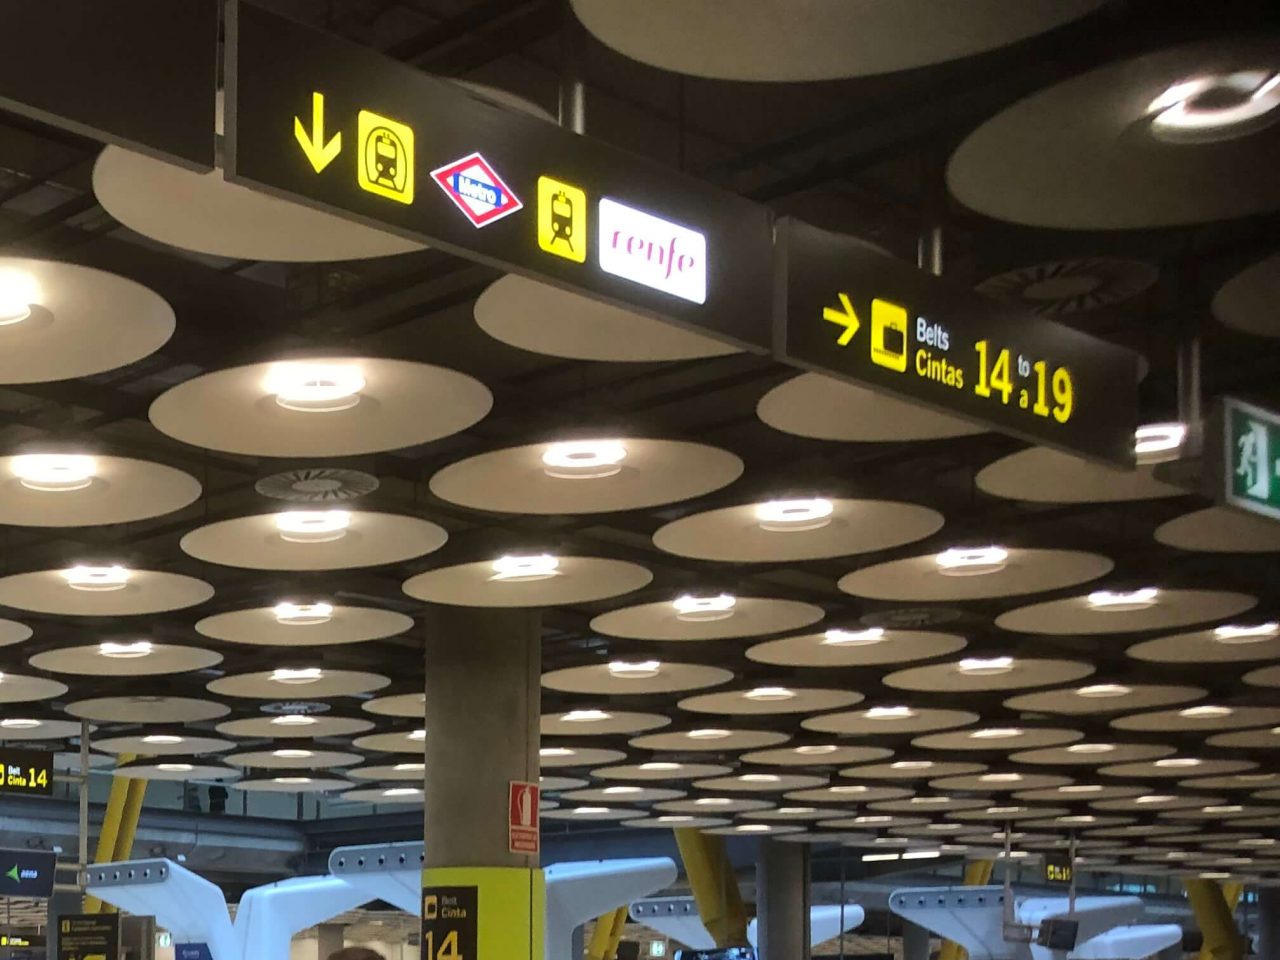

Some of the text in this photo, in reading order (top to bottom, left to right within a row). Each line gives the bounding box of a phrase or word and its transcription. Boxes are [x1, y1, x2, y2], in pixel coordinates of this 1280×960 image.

[458, 175, 497, 205] Metro
[611, 230, 695, 279] renfe
[916, 317, 950, 351] Belts
[915, 348, 964, 389] Cintas
[974, 340, 1073, 424] 14 to 19
[1019, 389, 1029, 409] a
[7, 767, 48, 789] Cinta 14
[441, 907, 467, 919] Cinta
